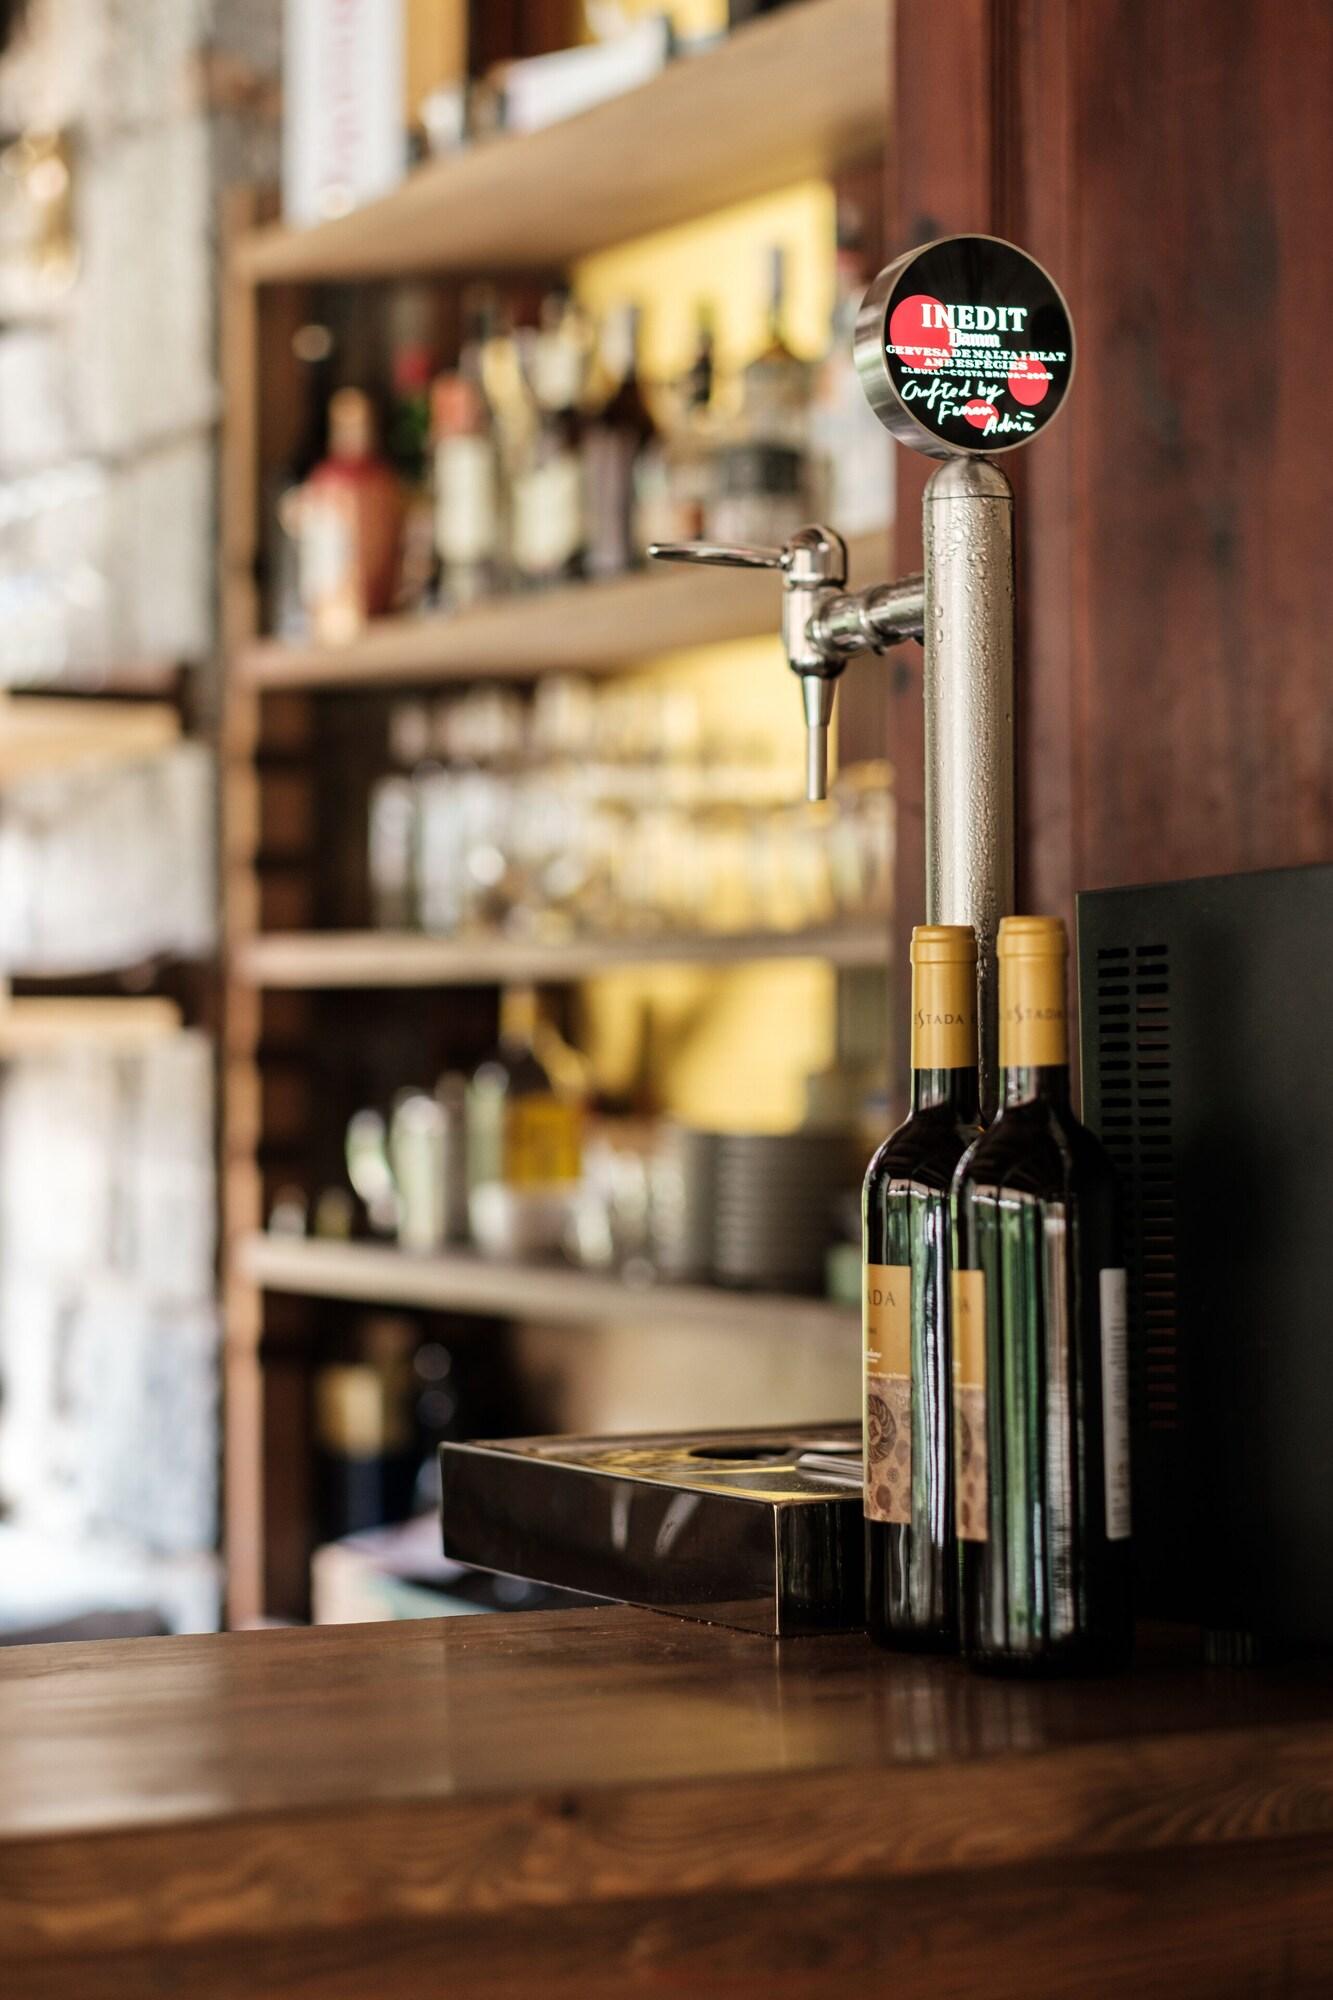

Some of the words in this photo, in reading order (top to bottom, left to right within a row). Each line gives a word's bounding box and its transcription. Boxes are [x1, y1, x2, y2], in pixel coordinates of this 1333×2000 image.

[921, 303, 1027, 331] INEDIT
[948, 328, 1001, 348] Damm
[886, 345, 949, 357] CERVESA
[951, 349, 971, 359] DE
[1027, 351, 1067, 362] BLAT
[901, 378, 971, 409] Crafted
[977, 380, 1005, 404] by
